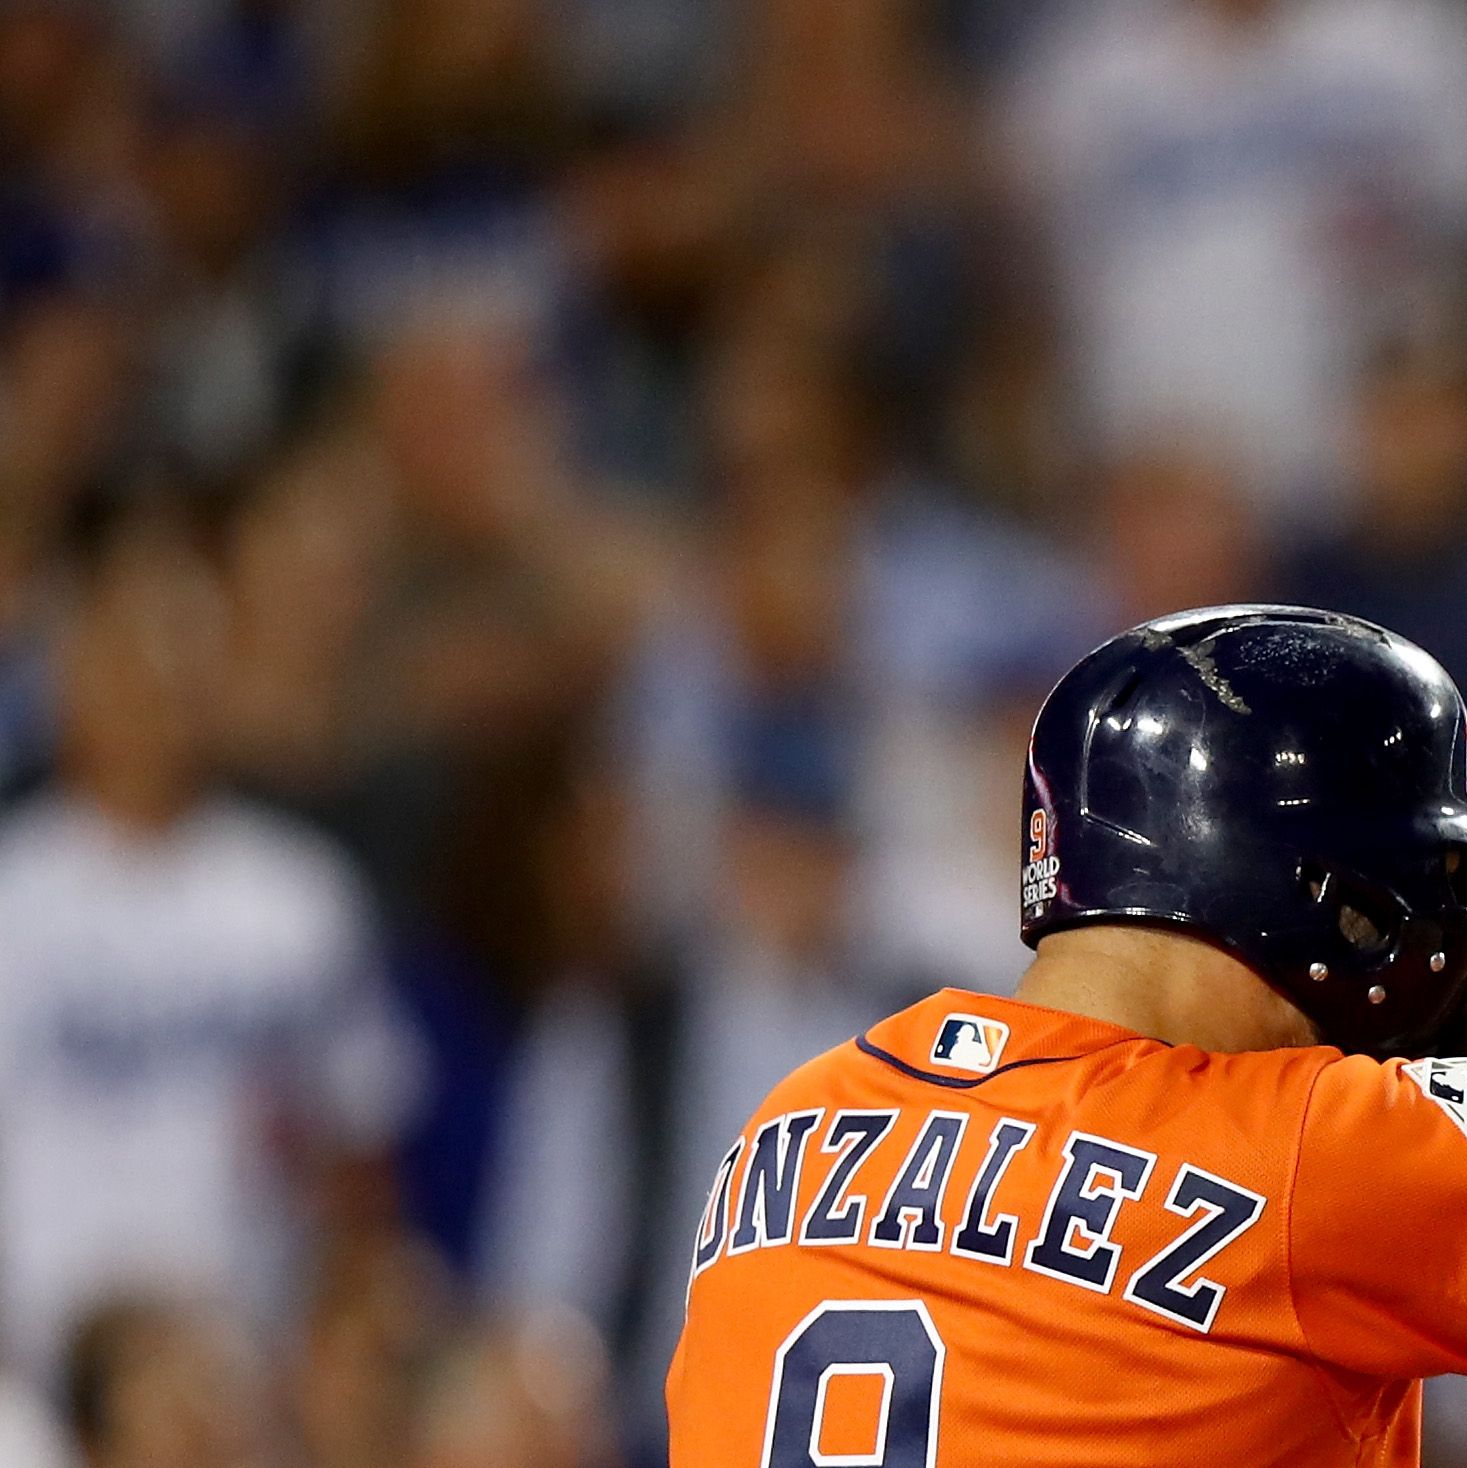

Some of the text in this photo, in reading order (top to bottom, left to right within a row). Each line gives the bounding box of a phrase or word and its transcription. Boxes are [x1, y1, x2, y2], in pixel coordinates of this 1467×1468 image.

[1030, 808, 1047, 862] 9
[1022, 877, 1057, 906] SERIES
[684, 1107, 1267, 1334] ONZALEZ
